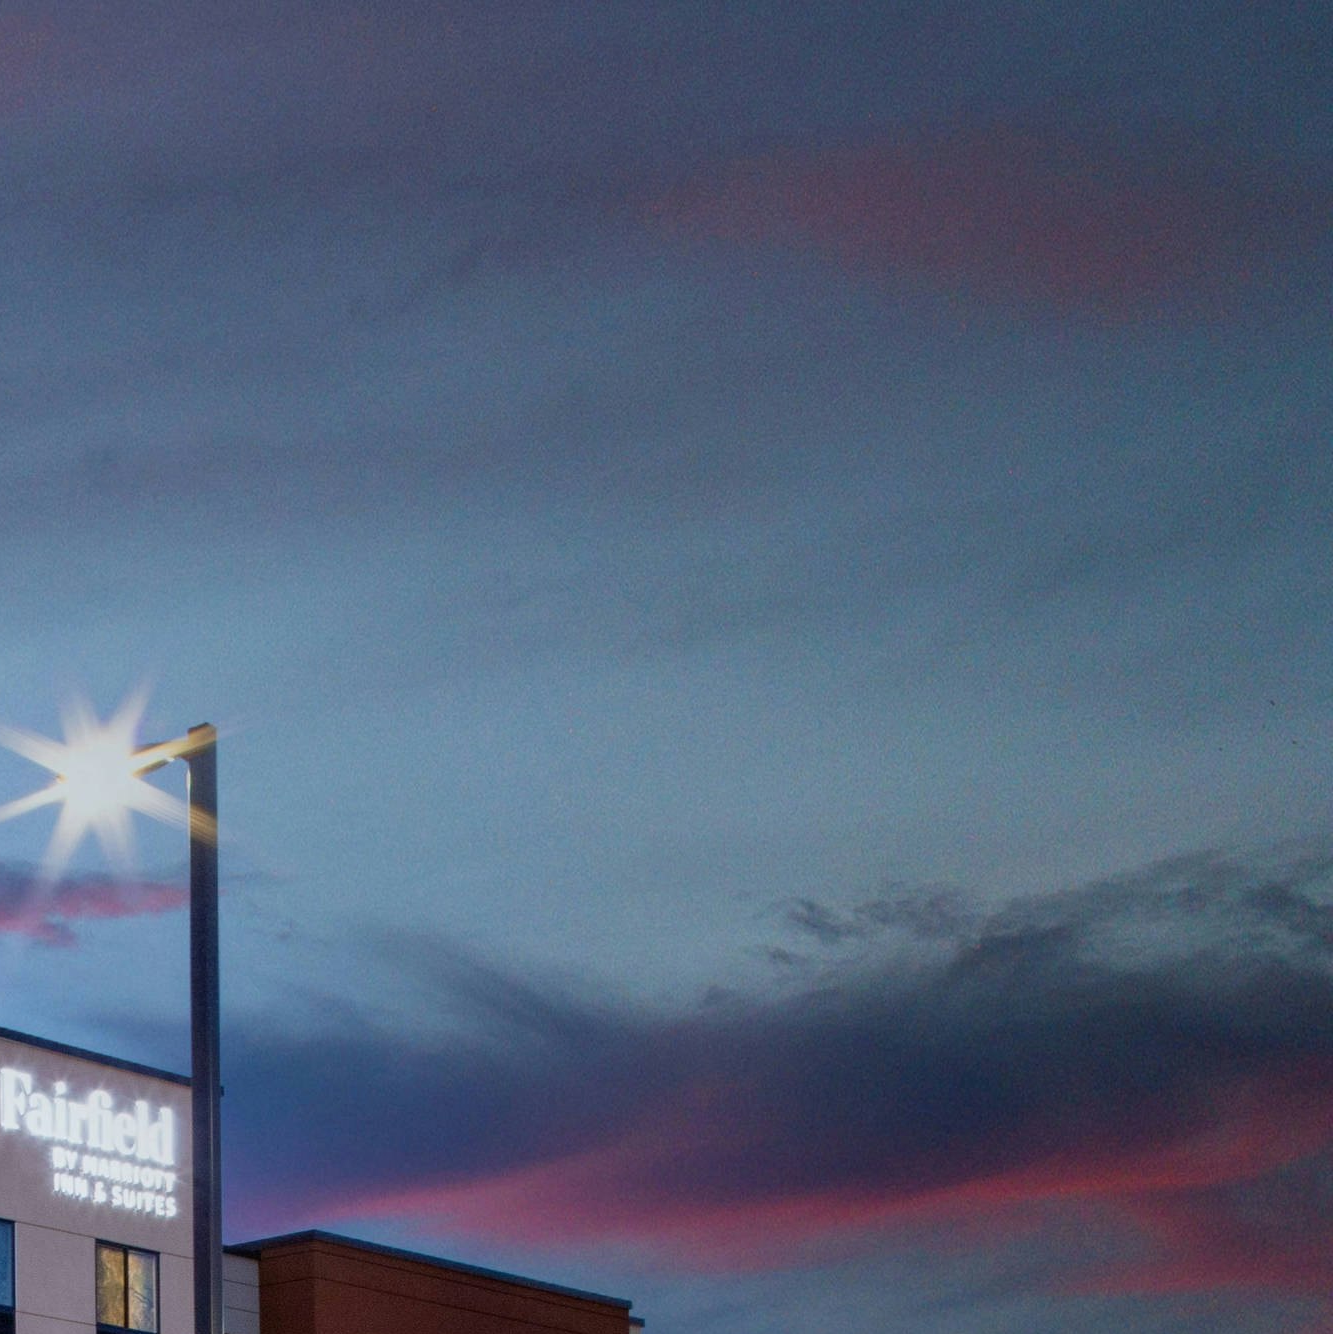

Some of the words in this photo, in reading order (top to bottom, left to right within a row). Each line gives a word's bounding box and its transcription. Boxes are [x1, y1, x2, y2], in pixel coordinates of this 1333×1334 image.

[0, 1067, 175, 1166] Fairfield
[52, 1147, 78, 1170] BY
[82, 1155, 177, 1193] MARRIOTT
[53, 1172, 89, 1200] INN
[92, 1181, 107, 1203] &
[112, 1185, 178, 1218] SUITES
